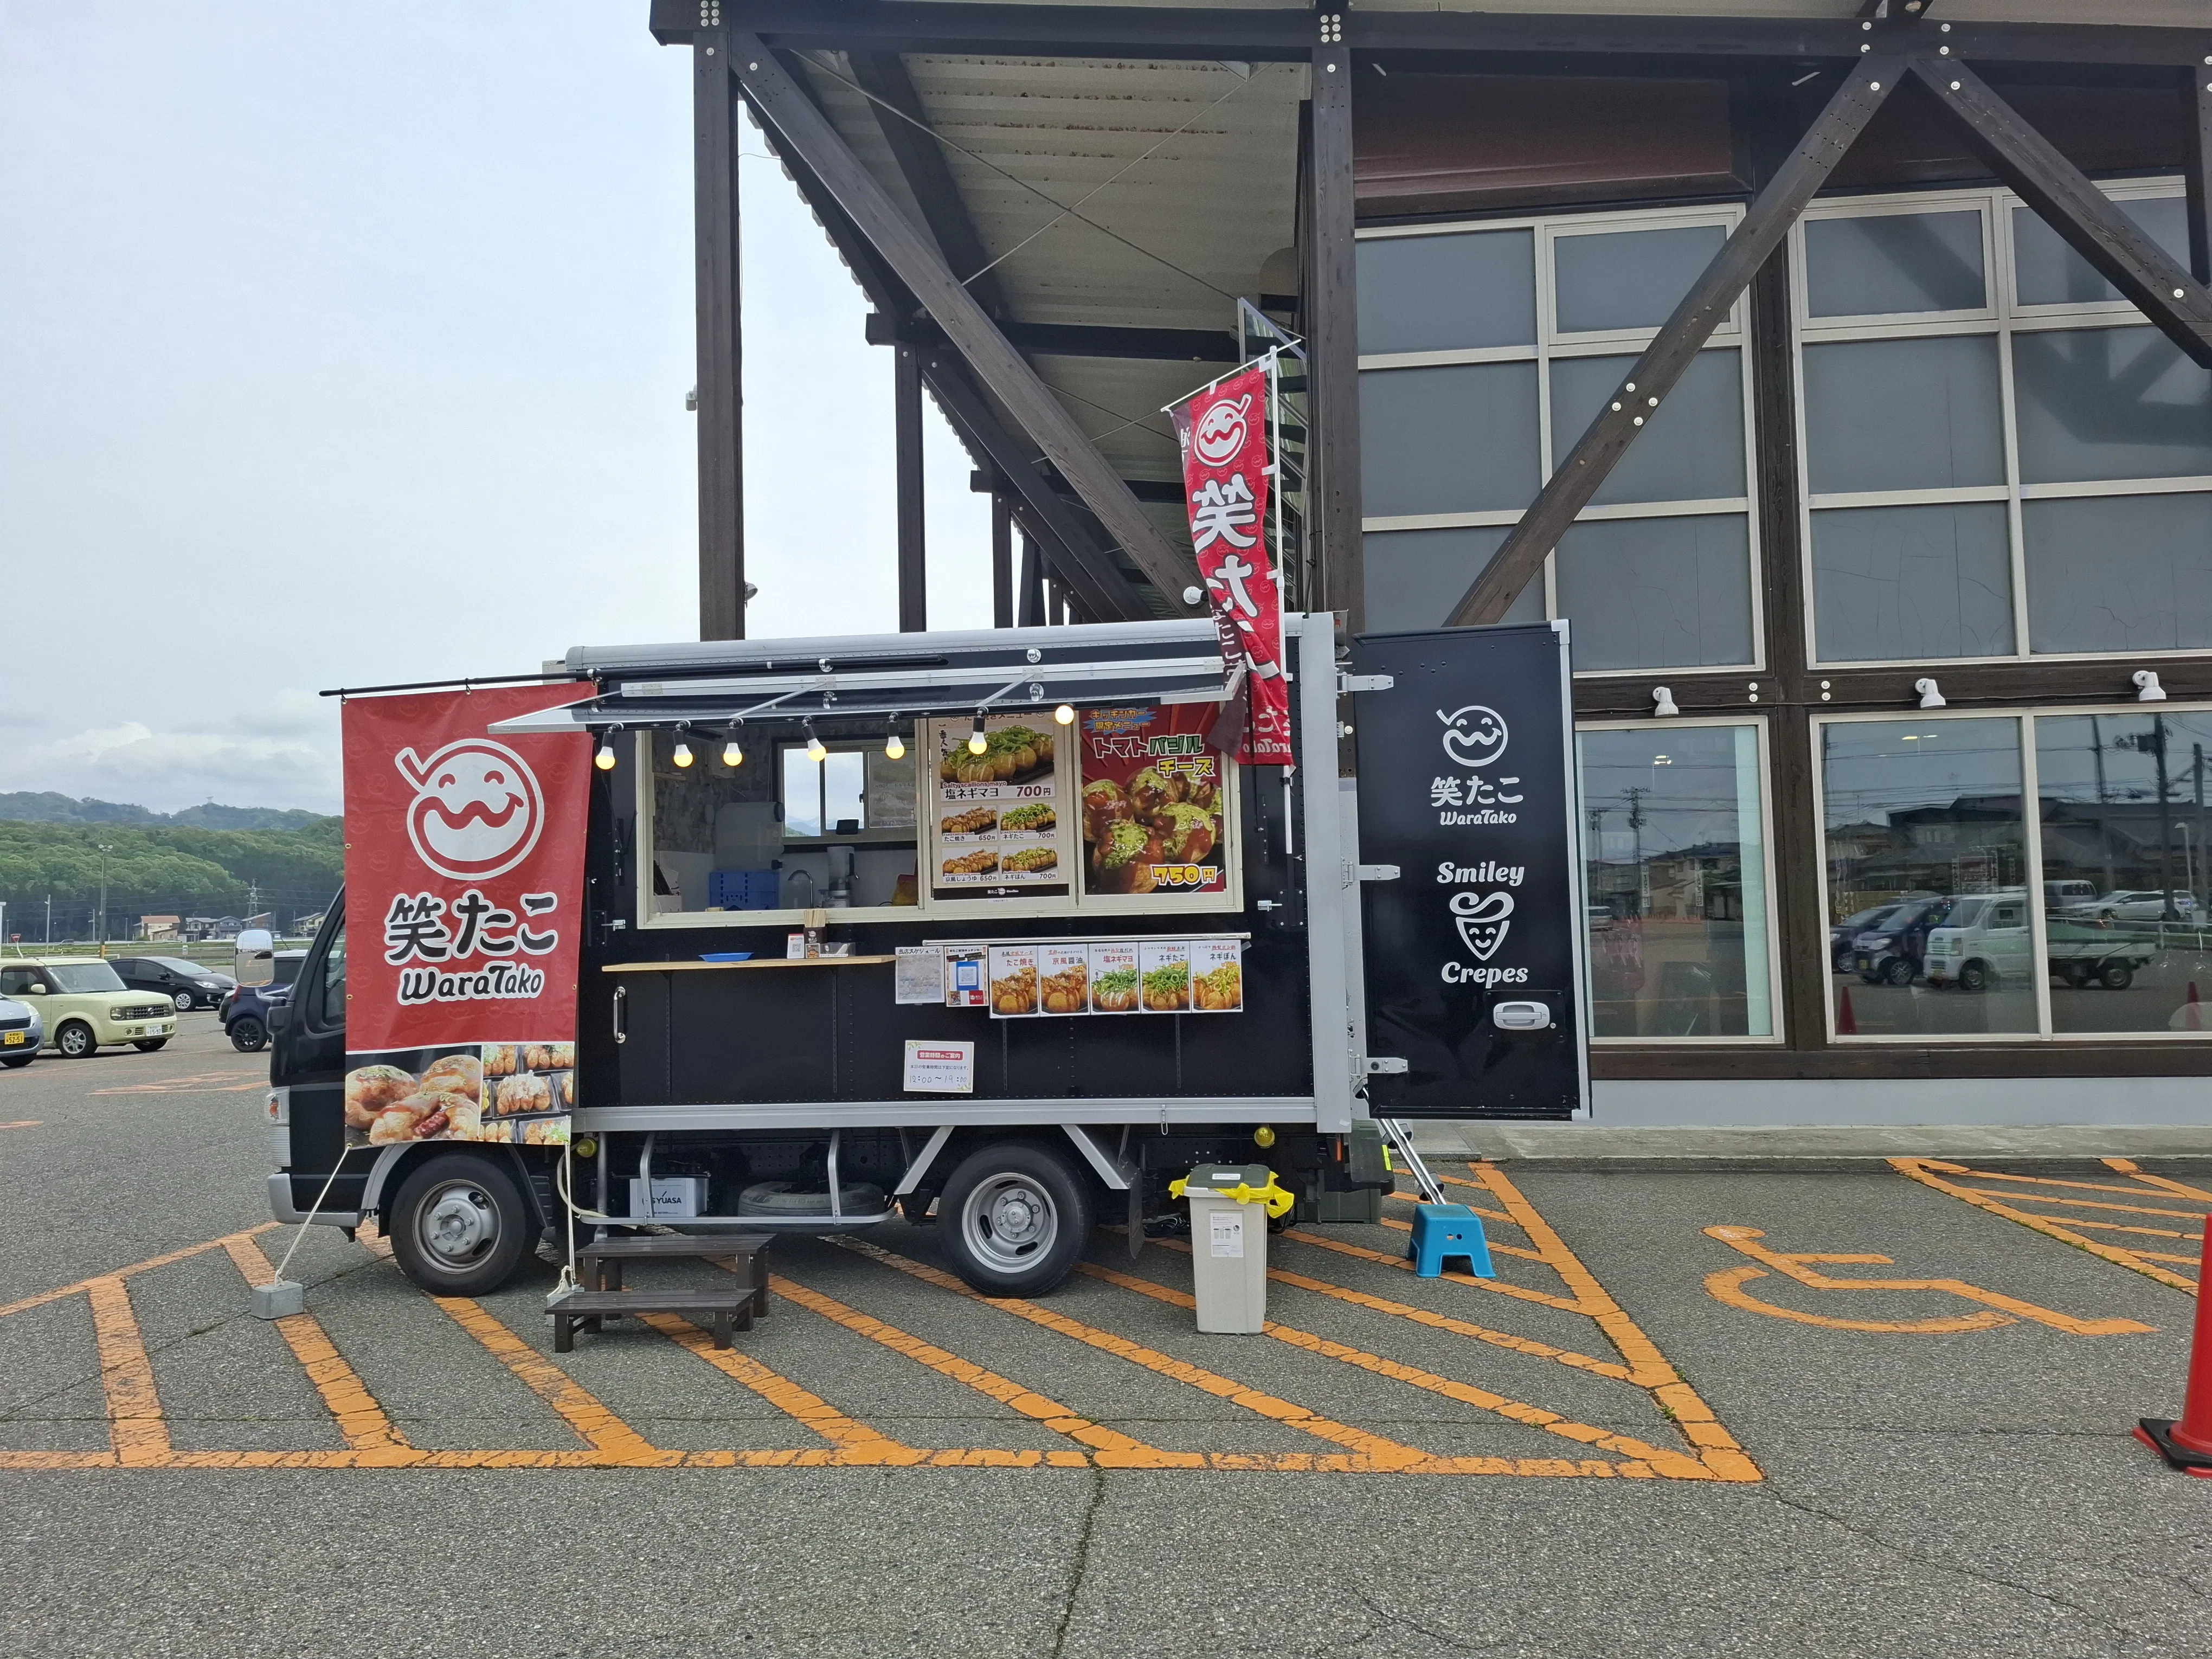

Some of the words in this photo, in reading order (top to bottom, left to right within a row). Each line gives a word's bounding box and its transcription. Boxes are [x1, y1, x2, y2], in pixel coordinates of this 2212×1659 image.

[1090, 709, 1146, 719] キッチンカー
[1095, 721, 1150, 731] 限定メニュー
[1093, 734, 1205, 758] トマトバジル
[1157, 756, 1216, 778] チーズ
[945, 788, 999, 800] 塩ネギマヨ
[1017, 786, 1051, 798] 700円
[1431, 775, 1523, 807] 笑たこ
[1440, 809, 1517, 825] WaraTako
[1149, 864, 1217, 885] 750円
[1437, 861, 1525, 886] Smiley
[385, 890, 557, 964] 笑たこ
[1007, 958, 1033, 967] たこ焼き
[1103, 955, 1133, 963] 塩ネギマヨ
[1159, 954, 1185, 962] ネギたこ
[1210, 952, 1236, 961] ネギぽん
[401, 963, 543, 1002] WaraTako
[1441, 962, 1528, 989] Crepes
